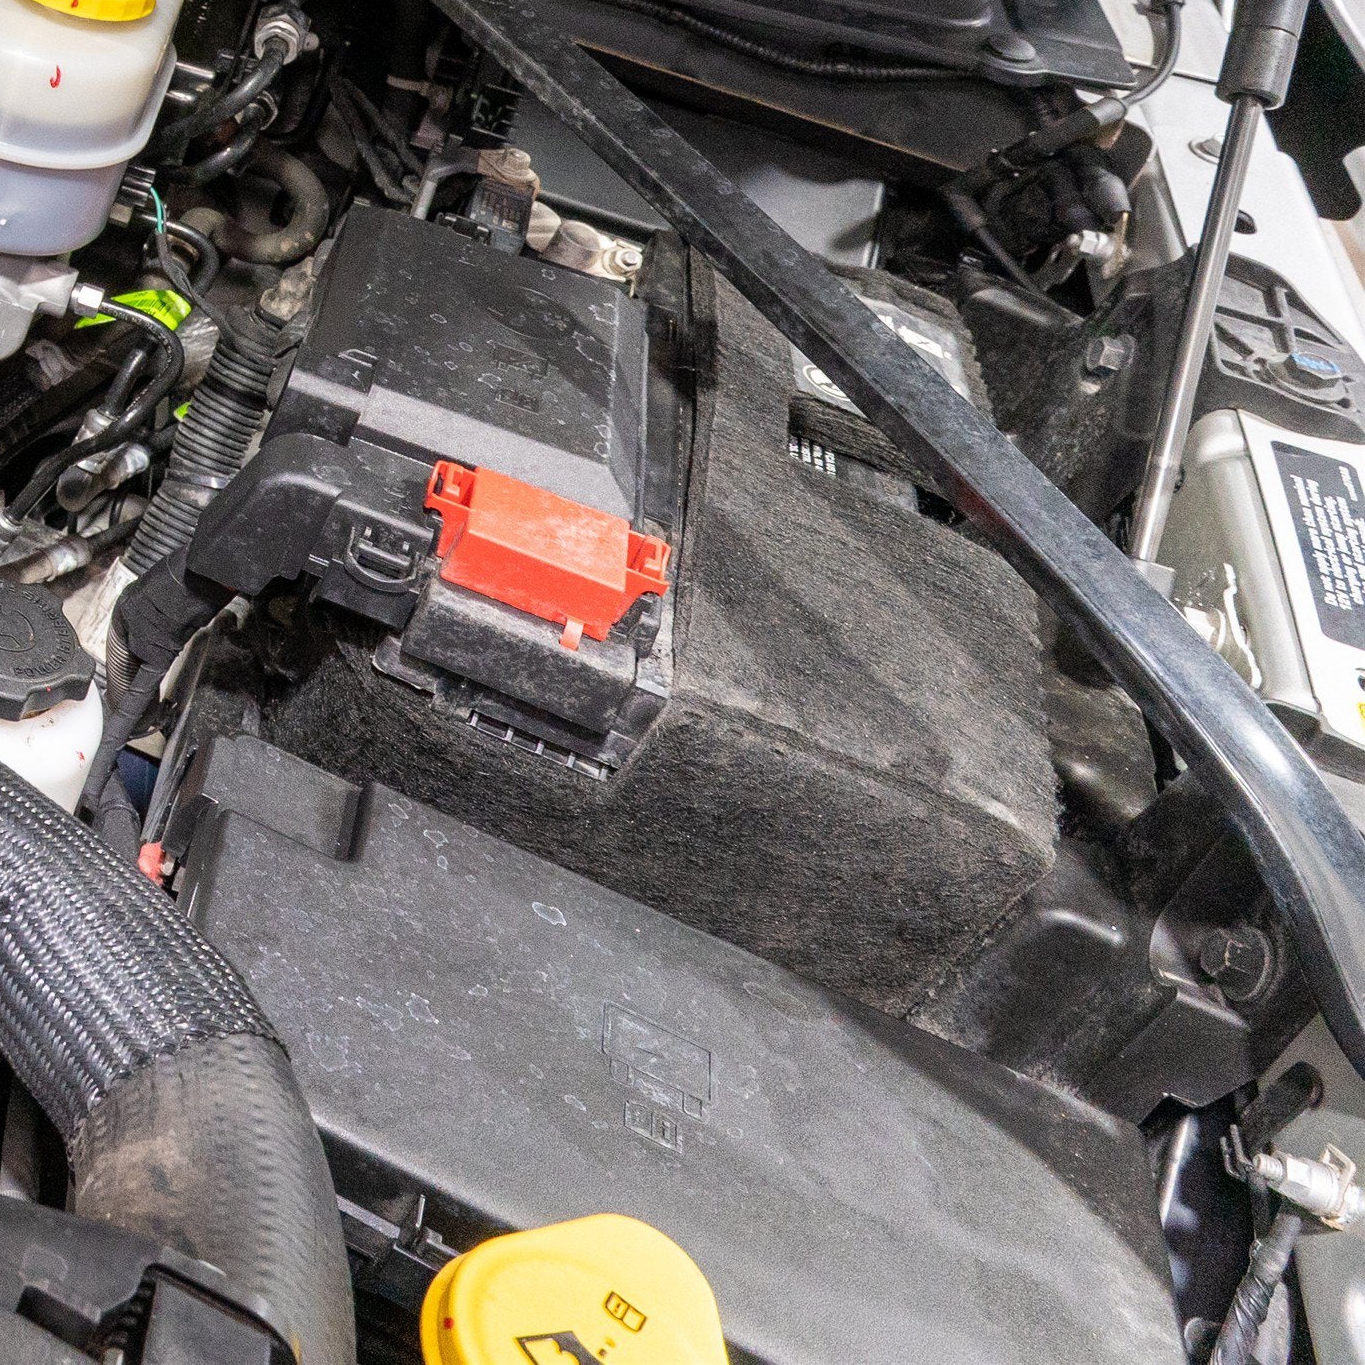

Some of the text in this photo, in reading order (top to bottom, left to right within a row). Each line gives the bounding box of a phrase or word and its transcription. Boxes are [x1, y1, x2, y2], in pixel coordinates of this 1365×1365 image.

[1302, 507, 1317, 528] than
[1308, 526, 1323, 550] more
[1319, 575, 1334, 592] not
[1323, 592, 1339, 607] Do
[1335, 589, 1353, 611] 12V
